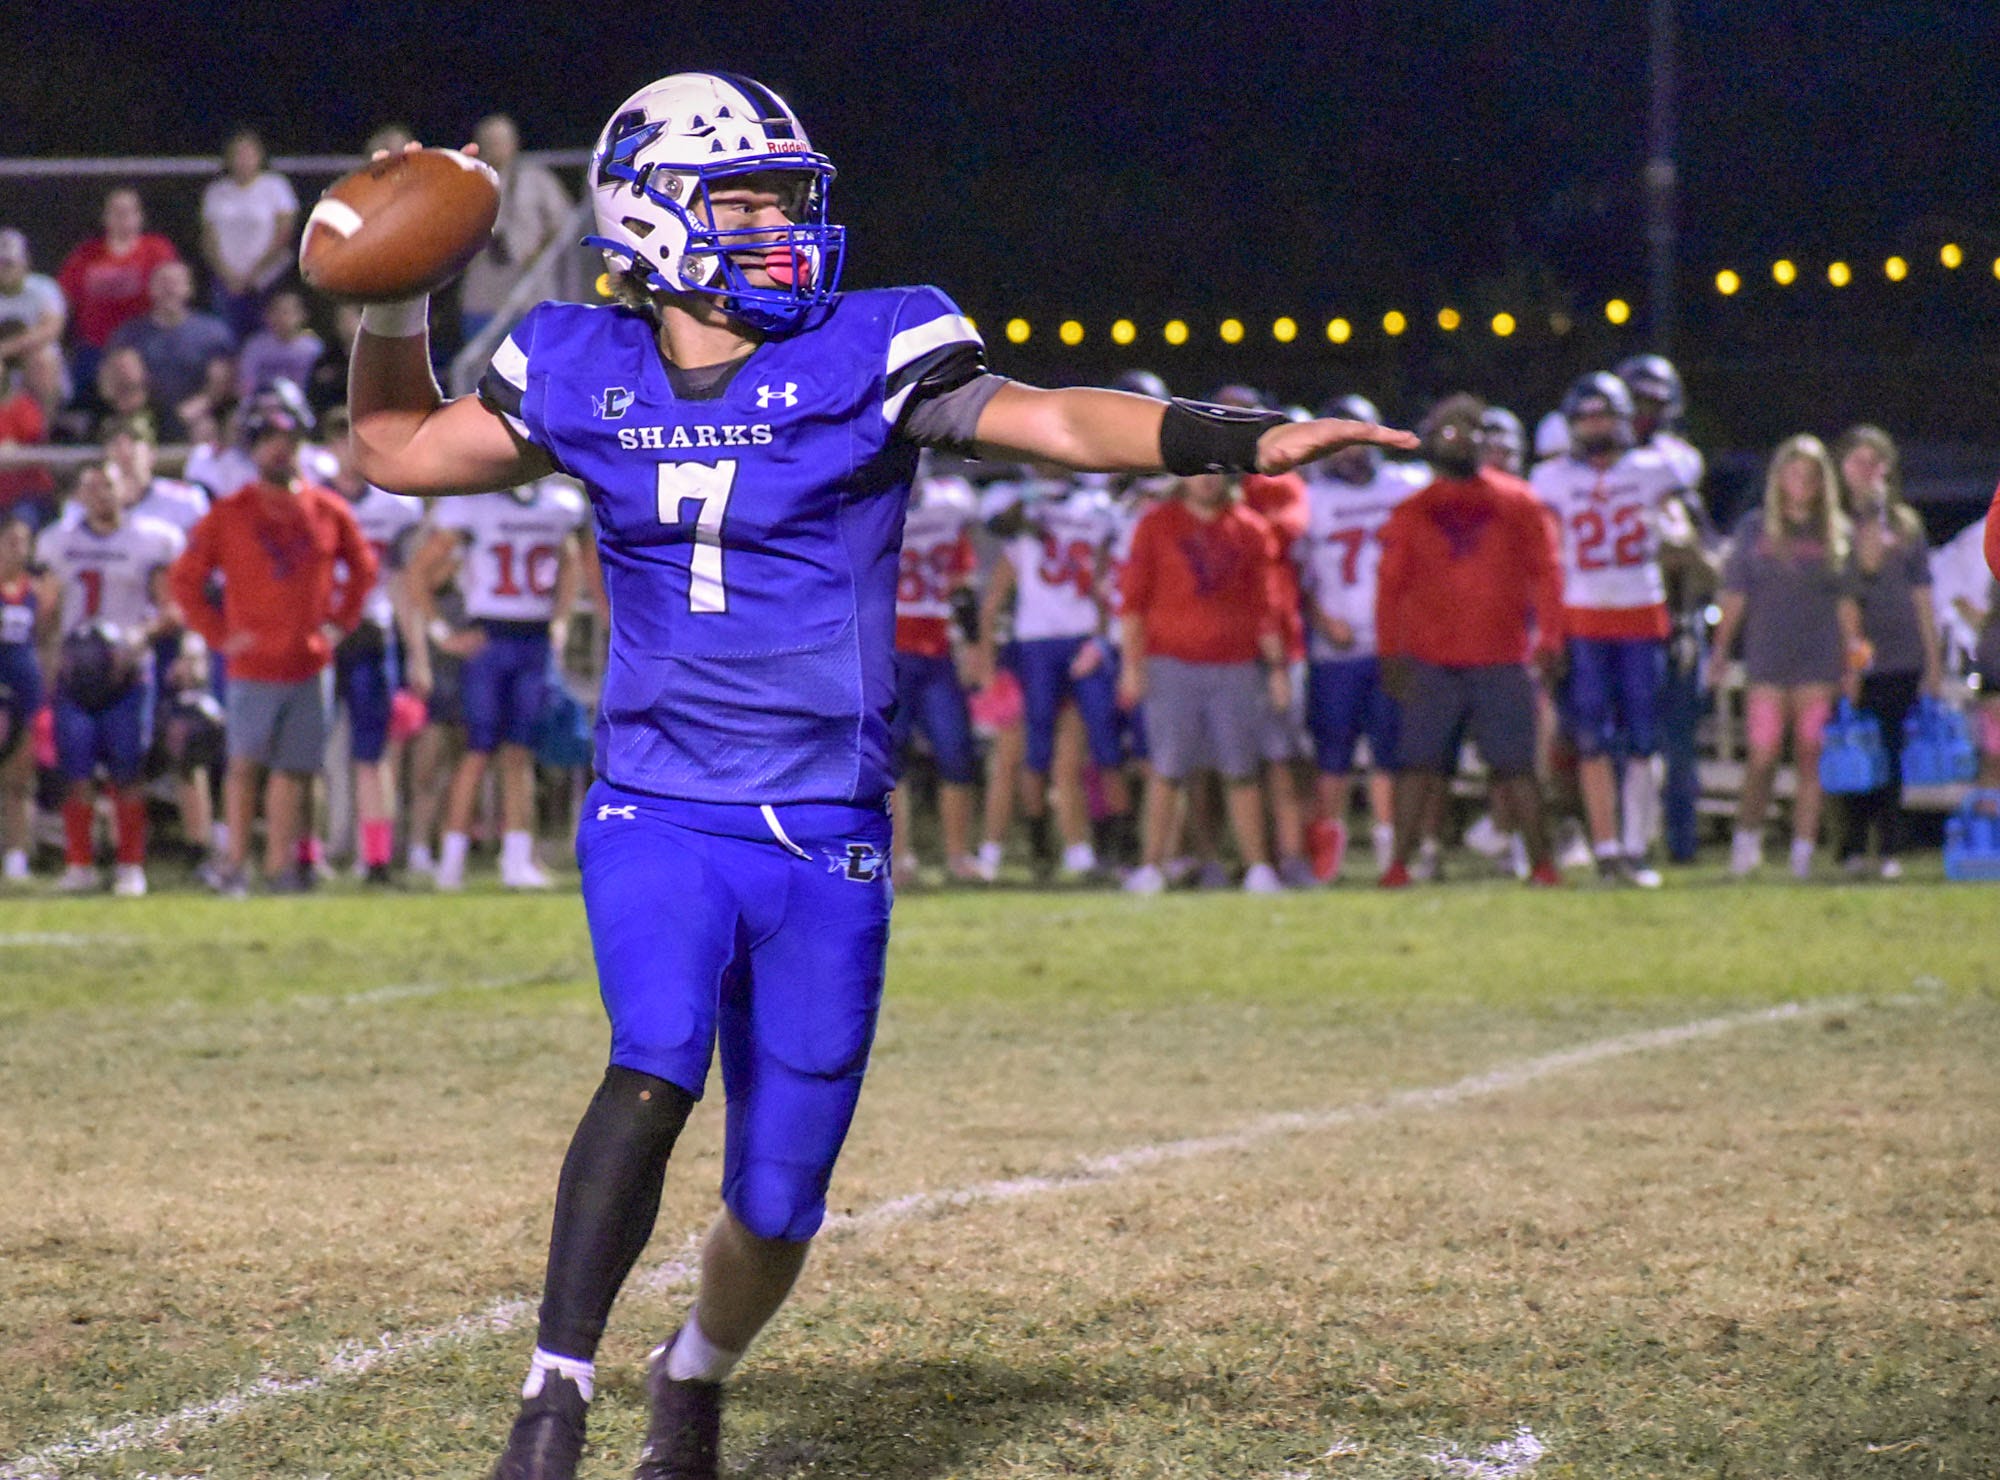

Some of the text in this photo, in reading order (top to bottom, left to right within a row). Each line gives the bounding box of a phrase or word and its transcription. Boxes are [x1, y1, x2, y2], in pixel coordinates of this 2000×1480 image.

[617, 424, 773, 449] SHARKS
[658, 459, 736, 613] 7
[1572, 503, 1647, 570] 22
[489, 541, 562, 597] 10
